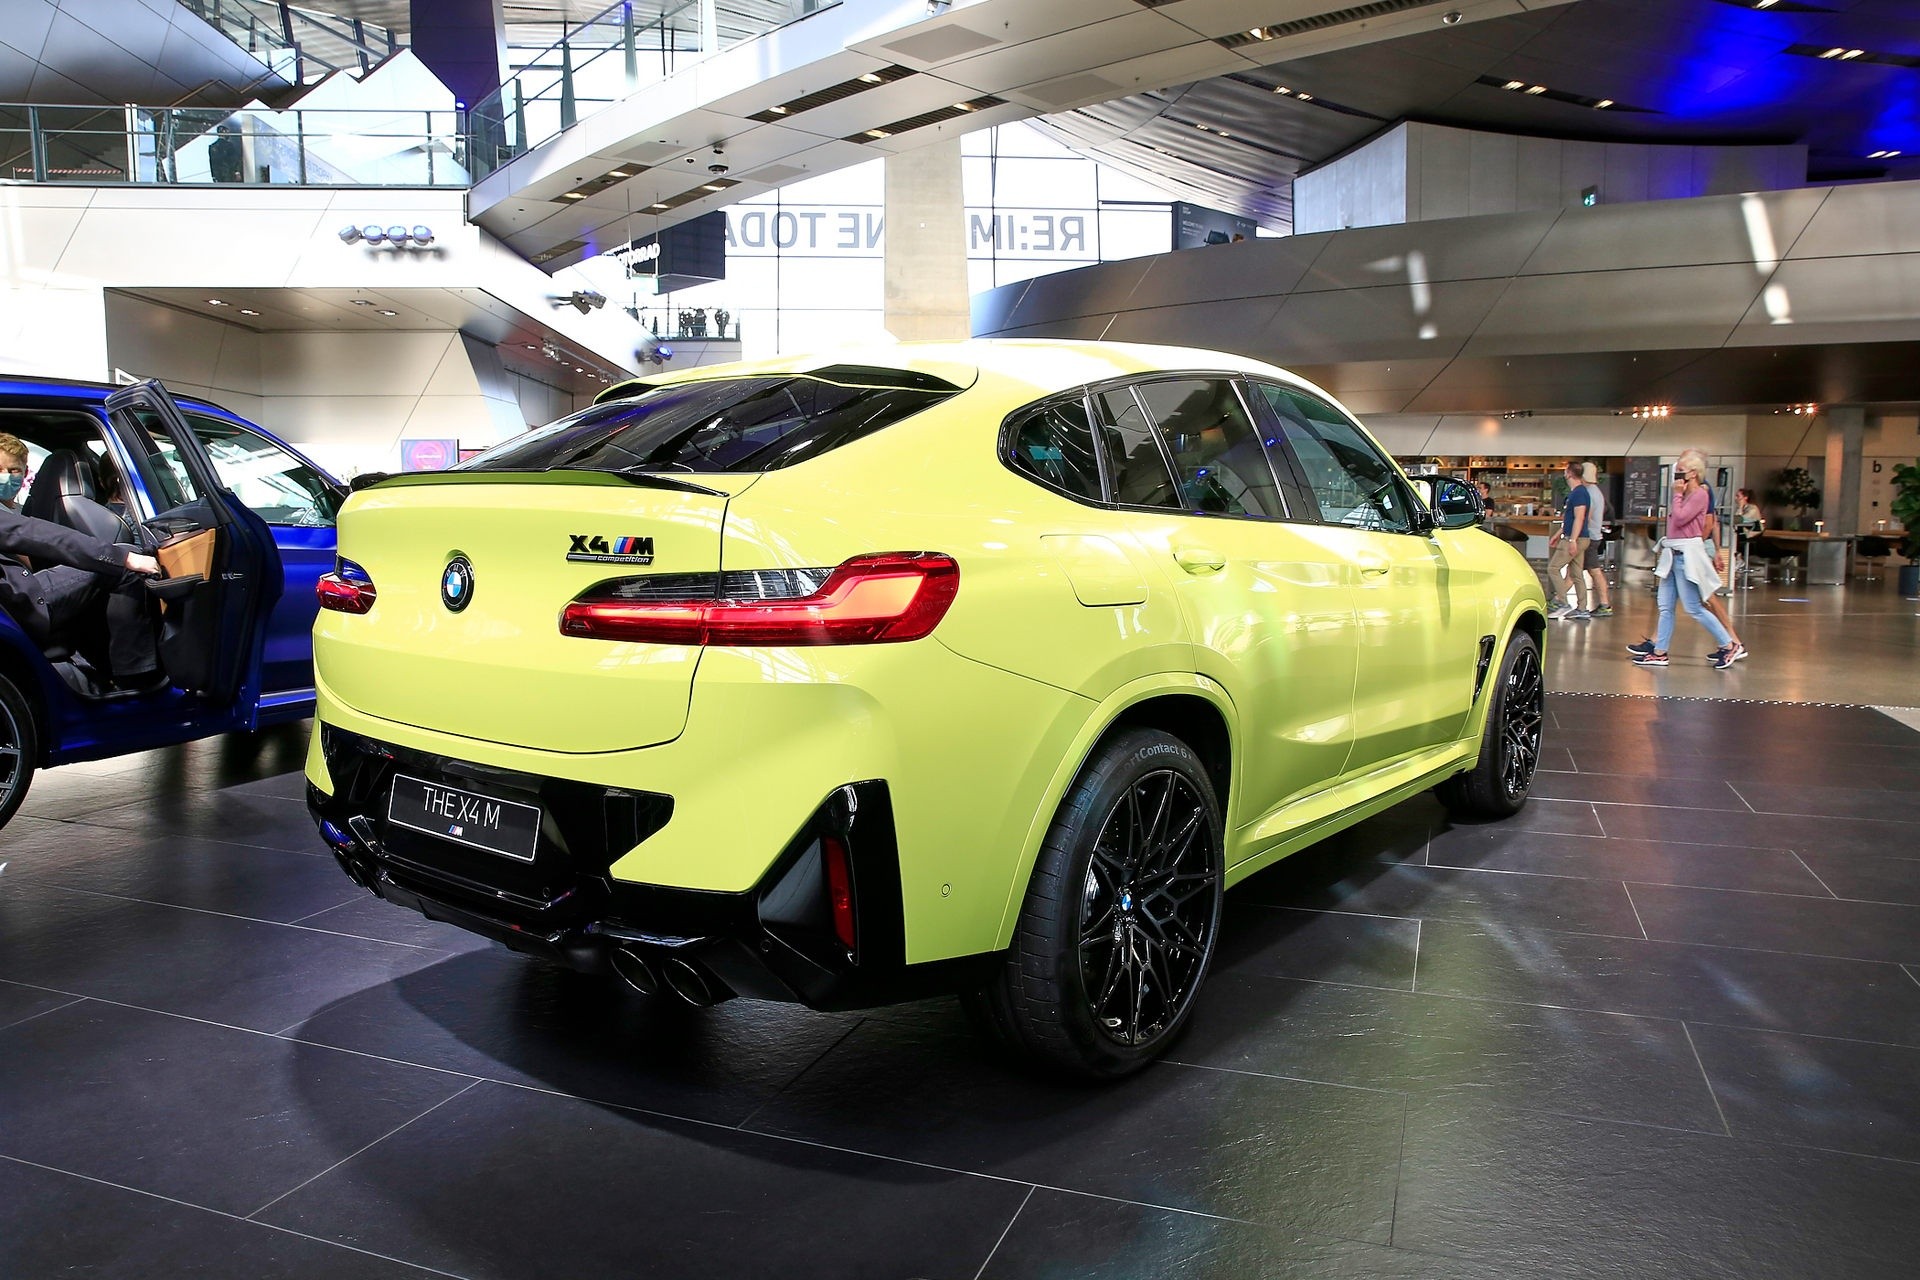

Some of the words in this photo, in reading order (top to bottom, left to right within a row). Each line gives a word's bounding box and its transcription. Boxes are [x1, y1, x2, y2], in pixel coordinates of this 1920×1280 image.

[617, 243, 660, 266] OTORRAD
[1873, 460, 1882, 473] b
[569, 534, 610, 553] X4
[597, 554, 650, 564] competition
[1181, 748, 1188, 759] 6
[423, 786, 456, 818] THE
[456, 795, 480, 825] X4
[483, 803, 500, 830] M
